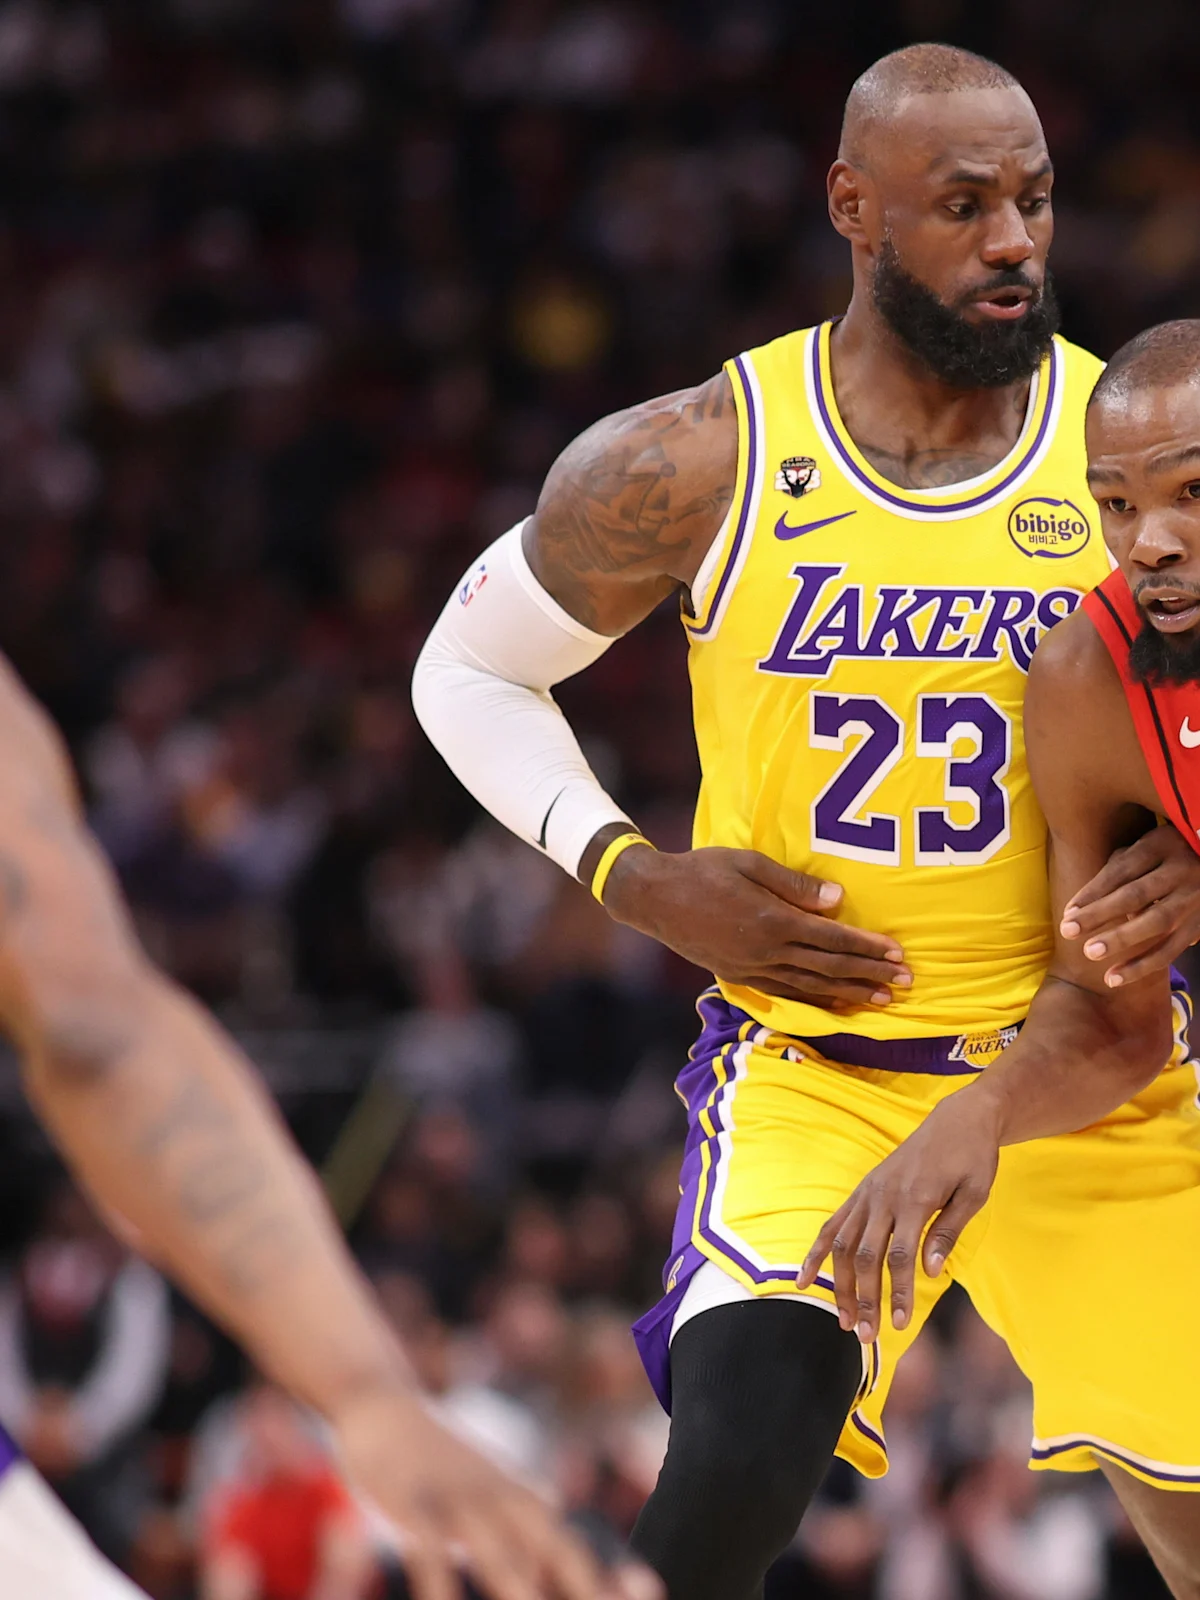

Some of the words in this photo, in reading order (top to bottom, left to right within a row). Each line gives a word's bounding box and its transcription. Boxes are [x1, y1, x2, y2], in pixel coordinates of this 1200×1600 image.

[1015, 513, 1085, 541] bibigo
[1028, 534, 1058, 545] 비비고
[755, 563, 1085, 676] LAKERS
[808, 690, 1012, 867] 23
